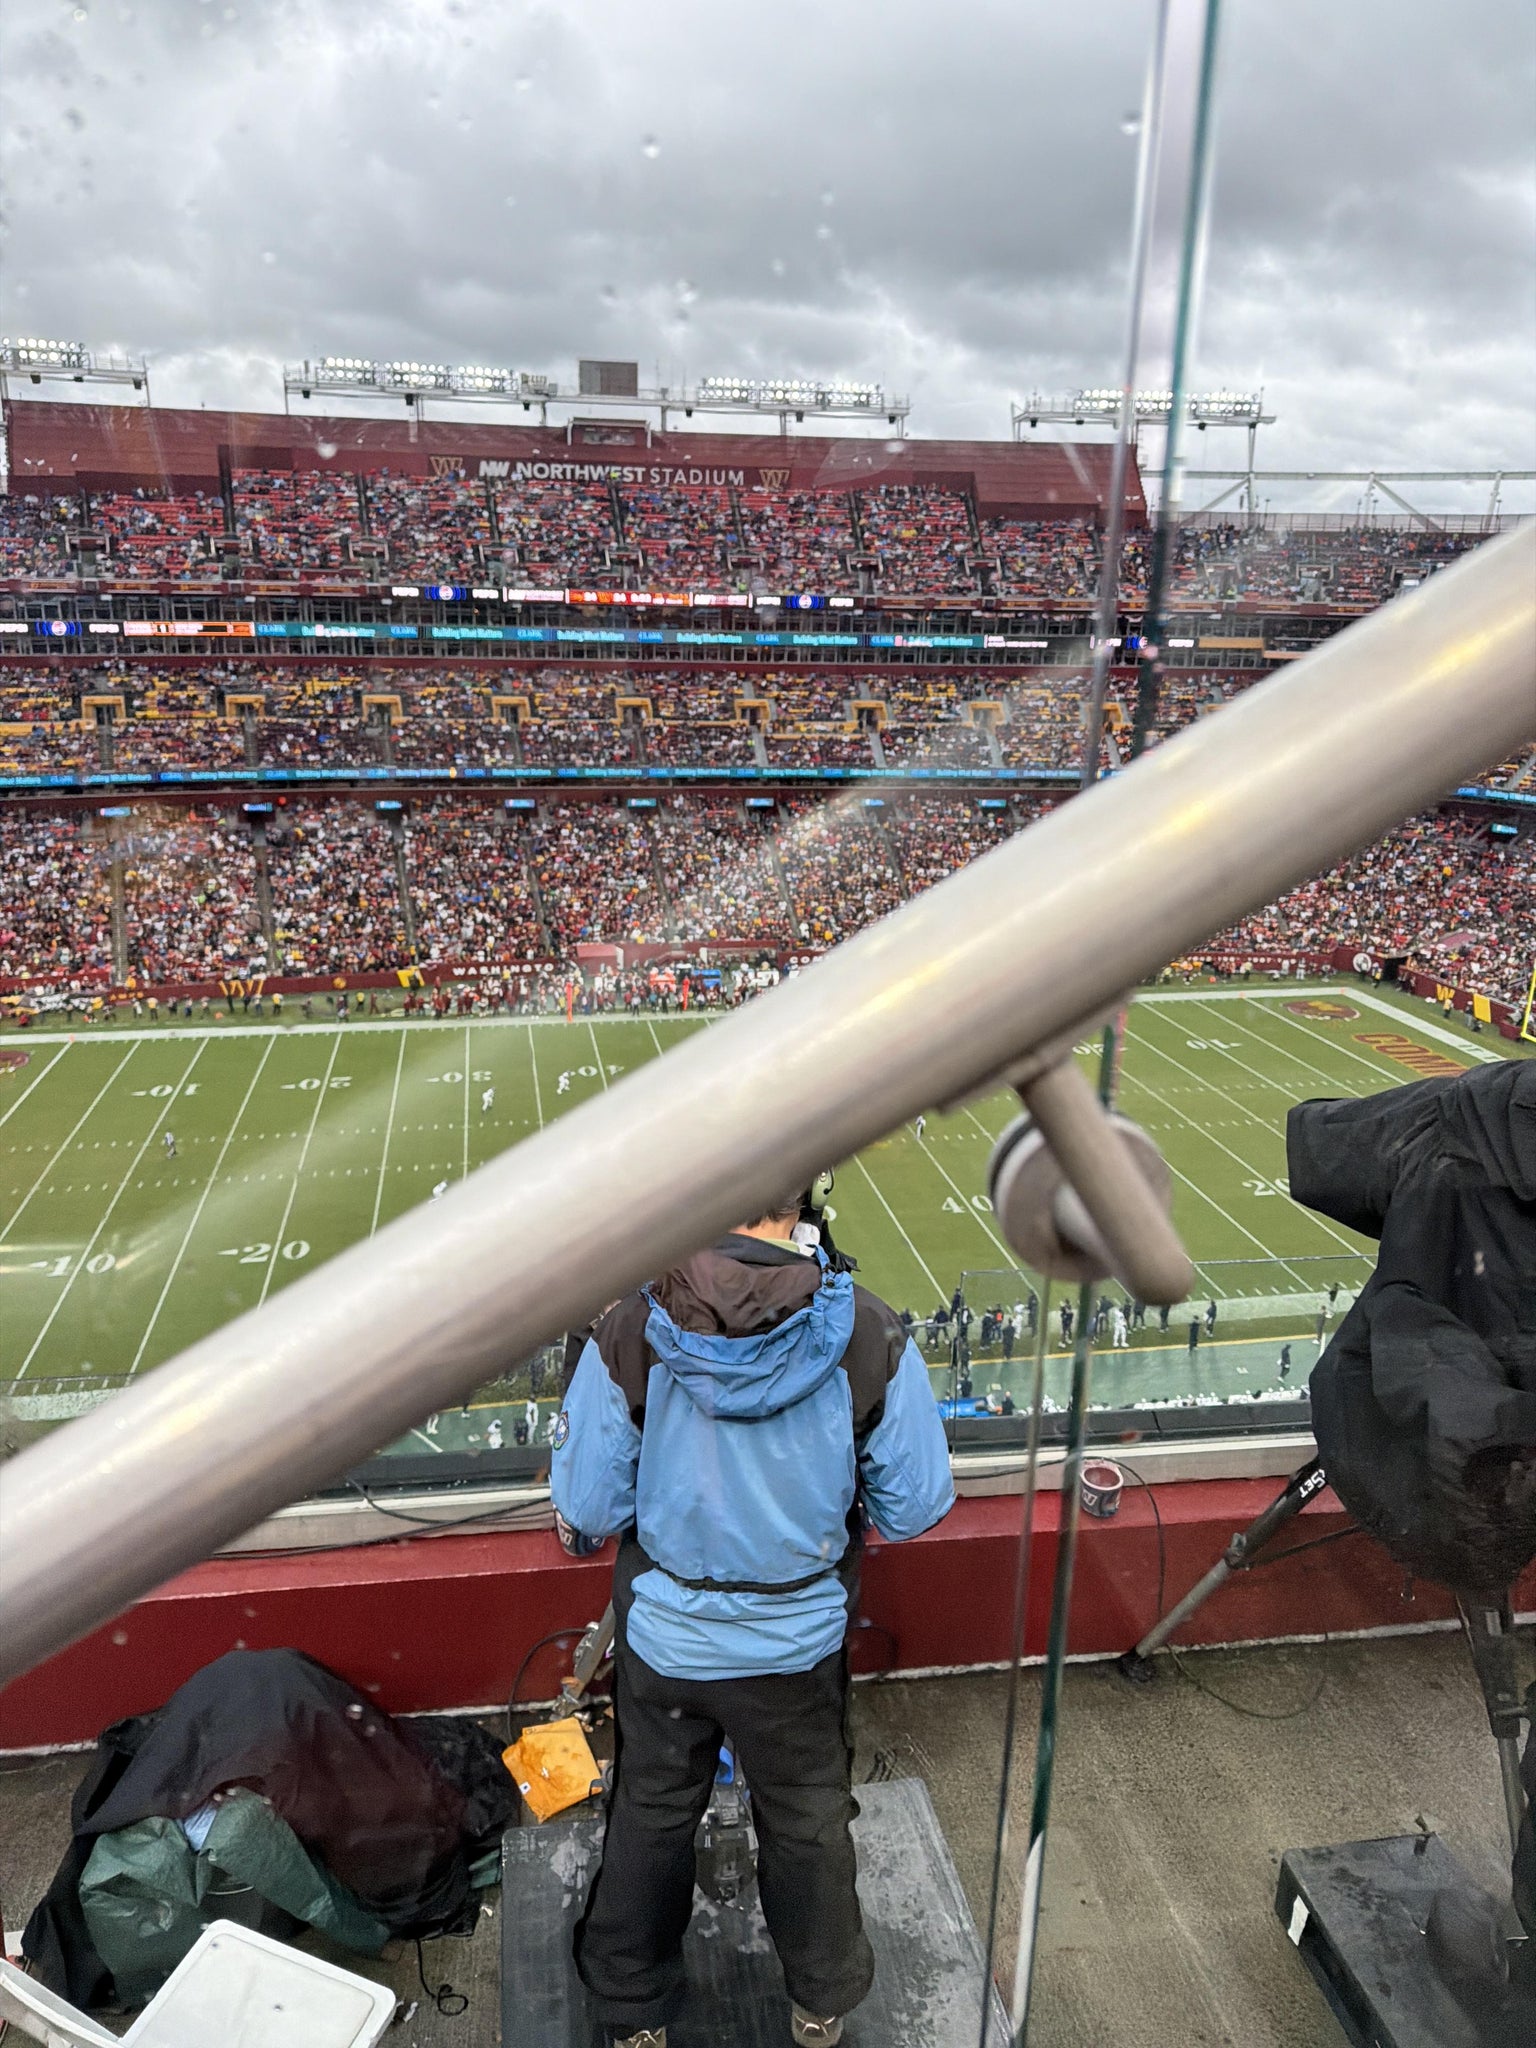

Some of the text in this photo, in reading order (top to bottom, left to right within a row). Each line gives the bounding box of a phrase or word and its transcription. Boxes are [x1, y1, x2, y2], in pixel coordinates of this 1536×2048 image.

[516, 462, 646, 483] NORTHWEST
[650, 467, 744, 486] STADIUM
[452, 962, 565, 977] WASHINGTO
[240, 1239, 311, 1264] 20
[47, 1253, 116, 1278] 10
